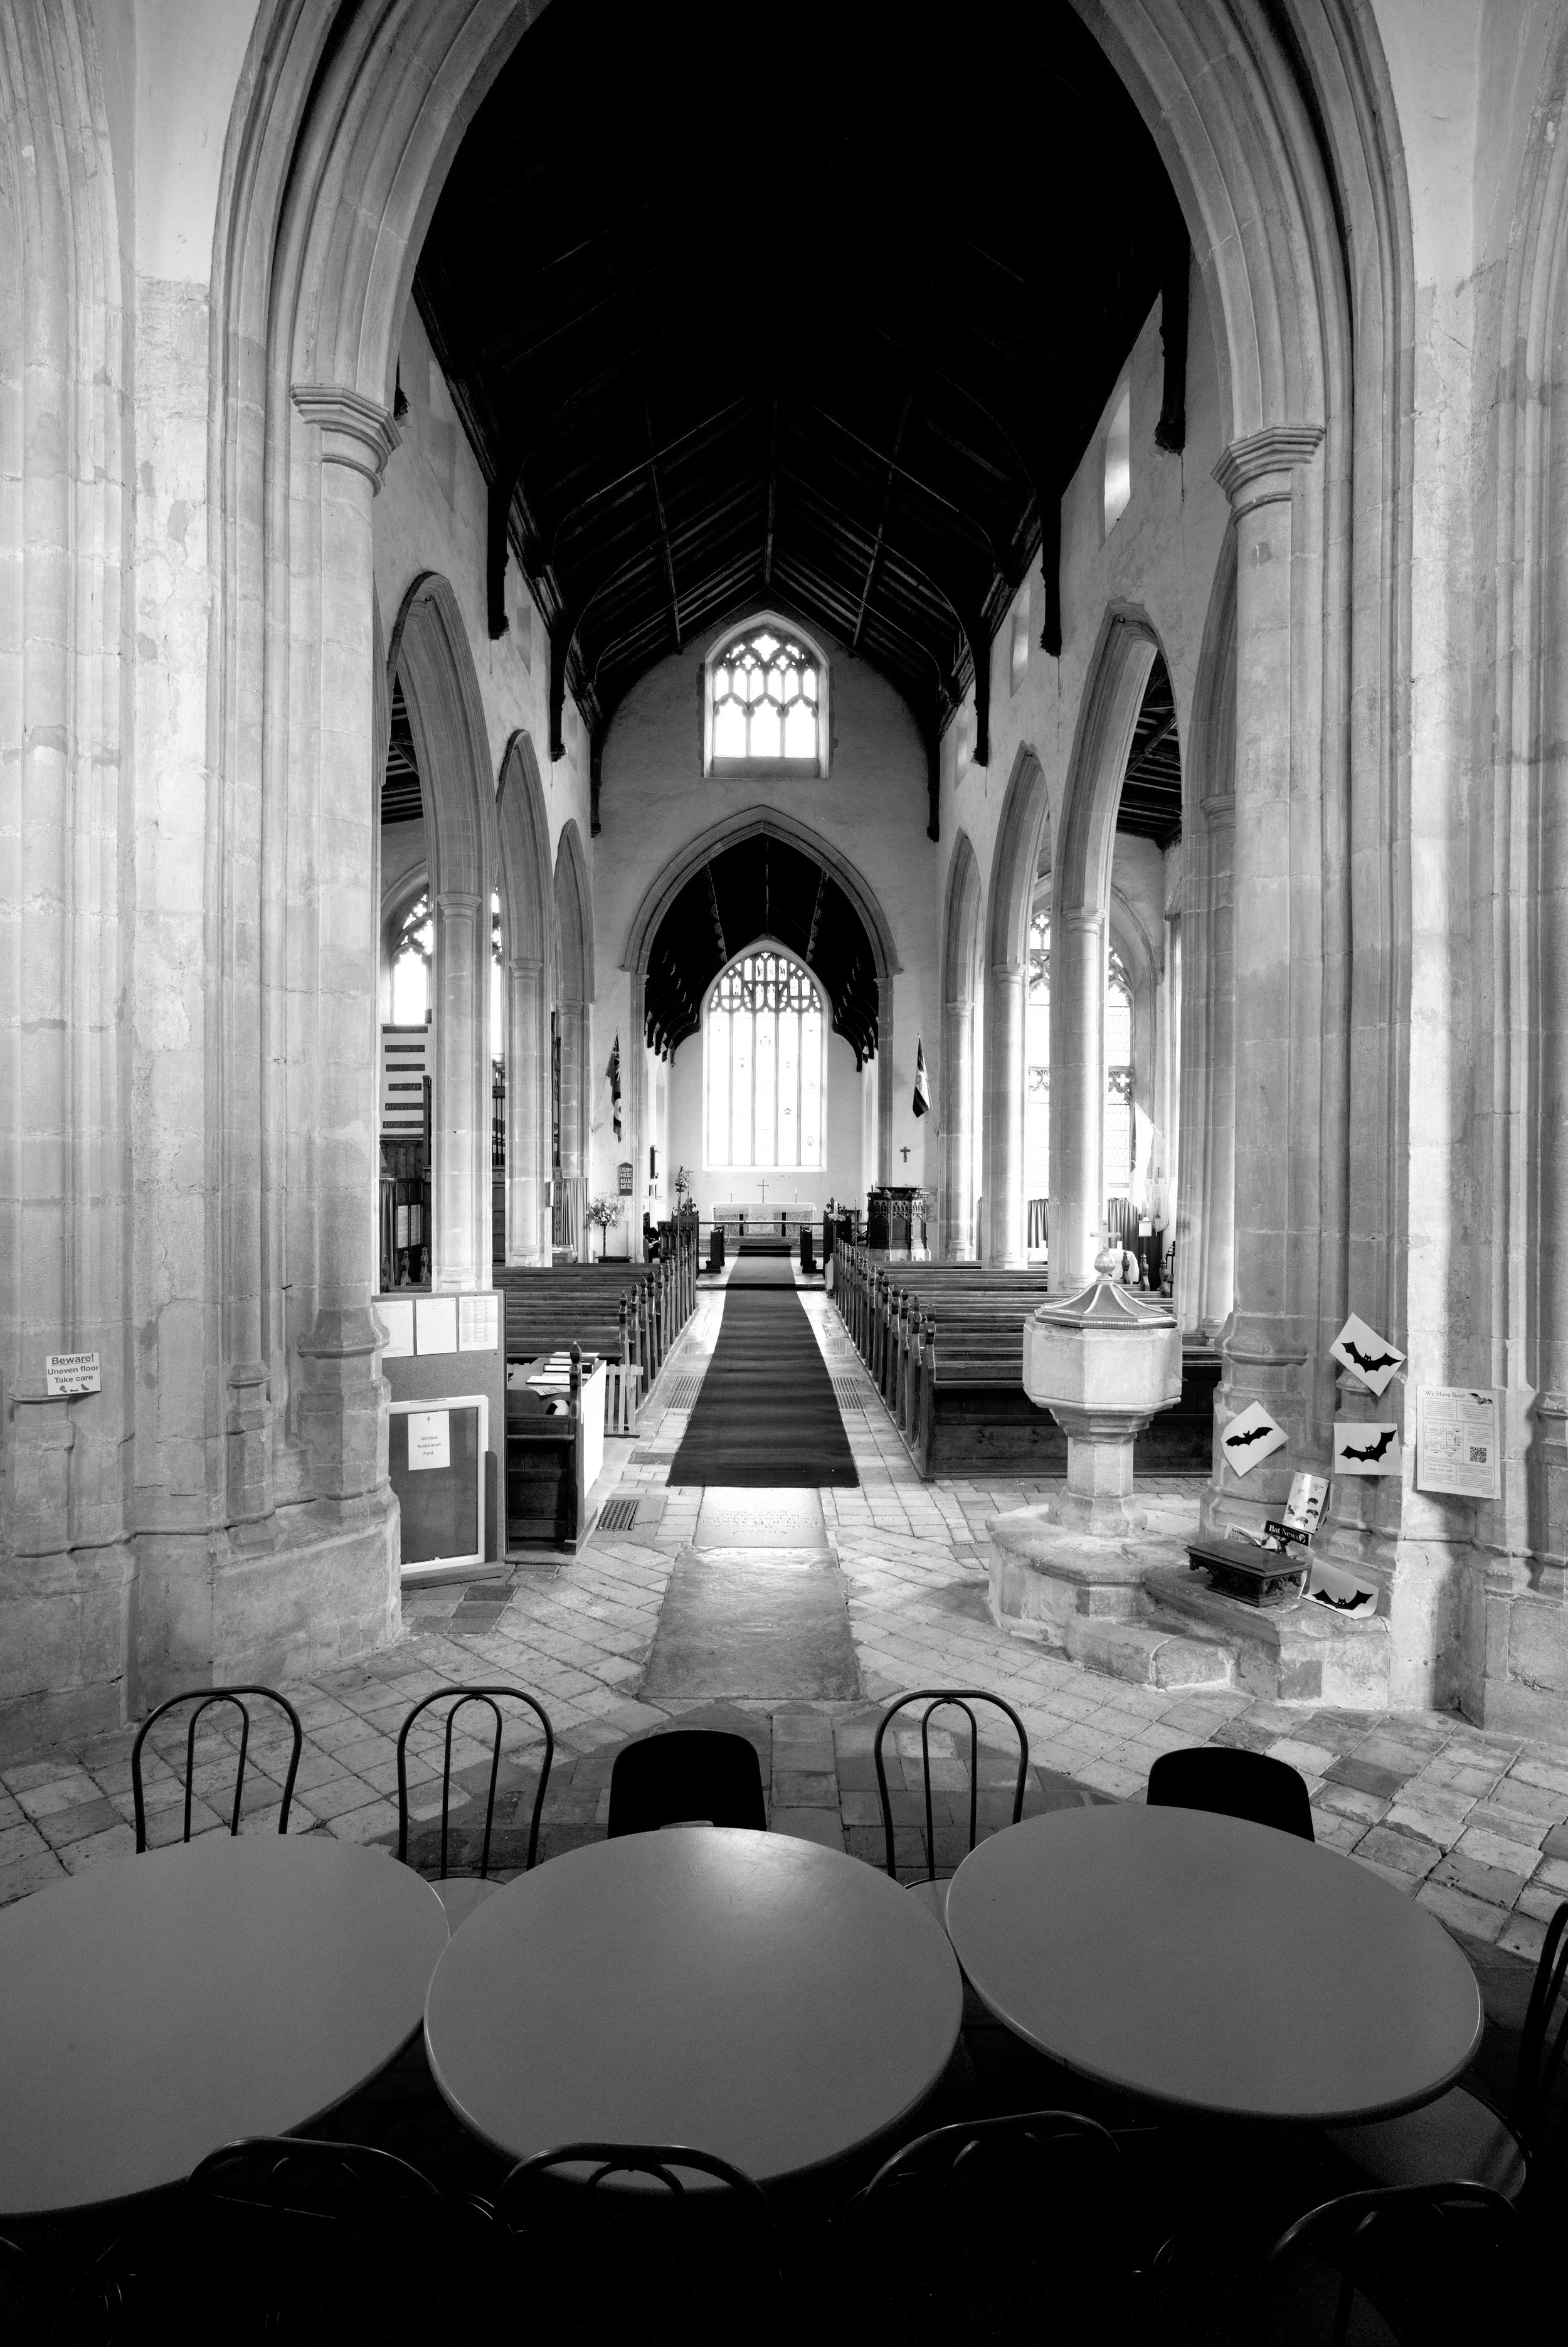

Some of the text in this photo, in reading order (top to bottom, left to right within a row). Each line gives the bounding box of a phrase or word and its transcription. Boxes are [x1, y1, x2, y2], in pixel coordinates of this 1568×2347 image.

[51, 1354, 95, 1365] Beware!
[47, 1367, 78, 1375] Uneven
[1269, 1524, 1300, 1541] Bat News
